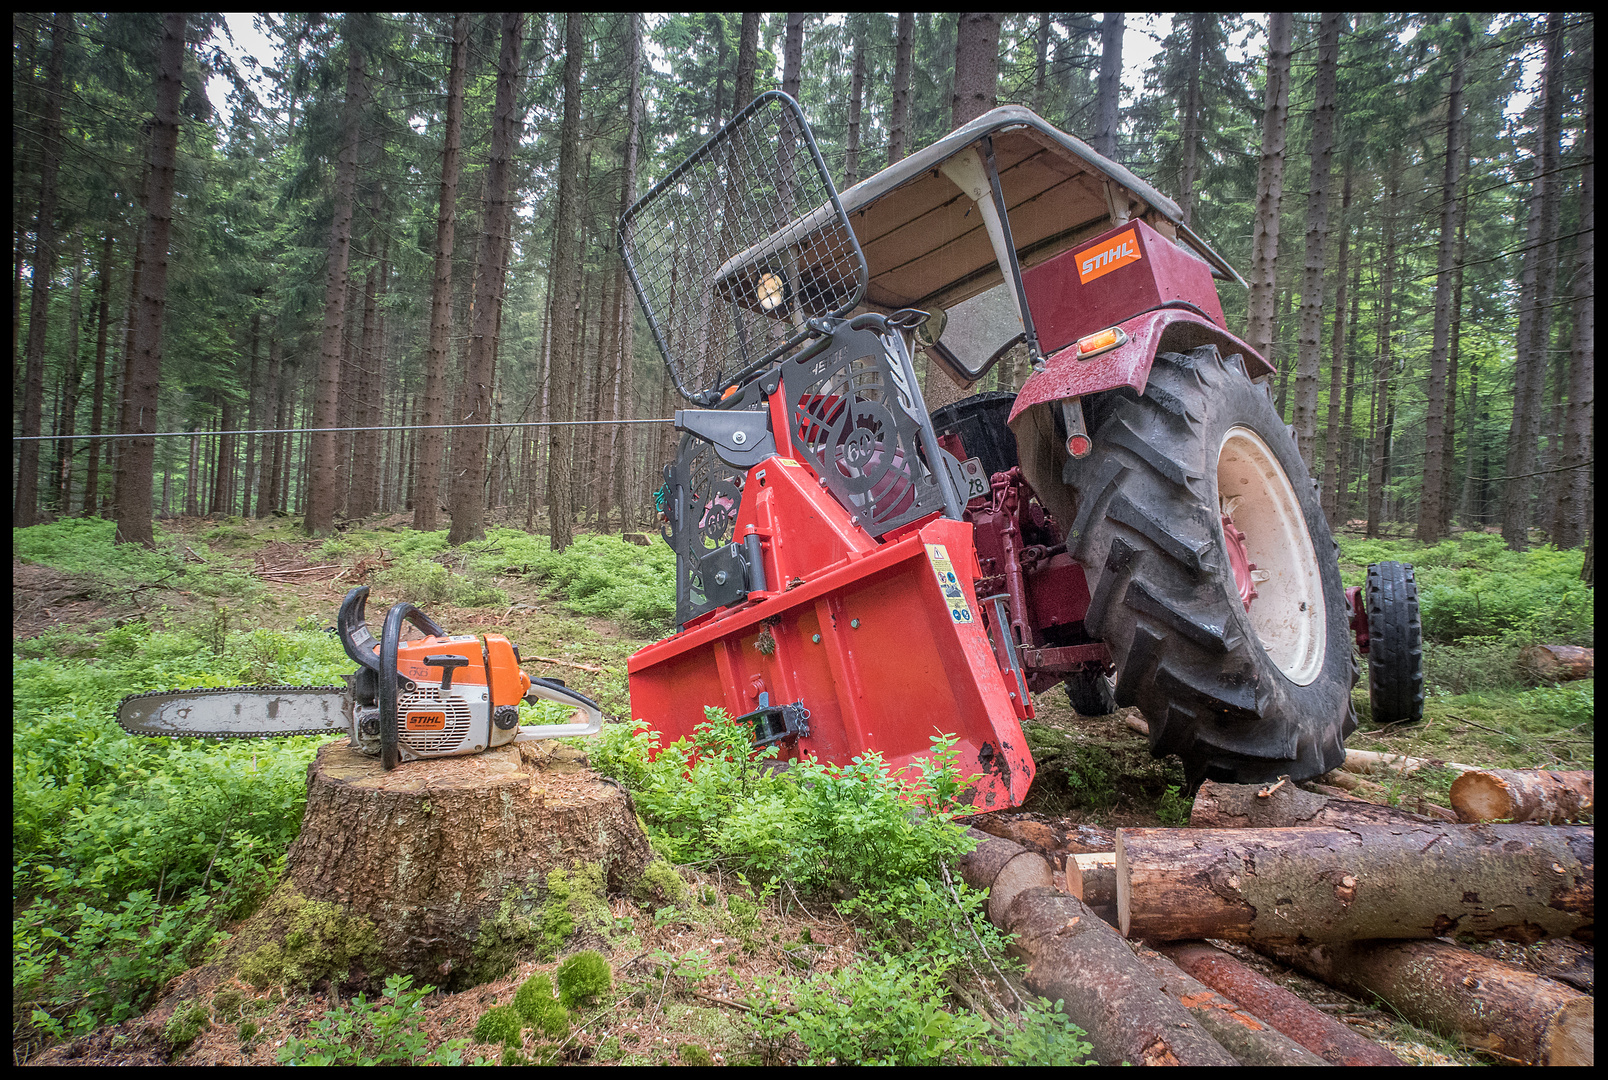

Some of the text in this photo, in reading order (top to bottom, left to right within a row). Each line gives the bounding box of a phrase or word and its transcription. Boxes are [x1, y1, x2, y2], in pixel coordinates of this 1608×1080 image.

[1081, 242, 1134, 275] STIHL
[847, 434, 871, 462] 60
[708, 508, 726, 535] 60
[409, 716, 441, 724] STIHL
